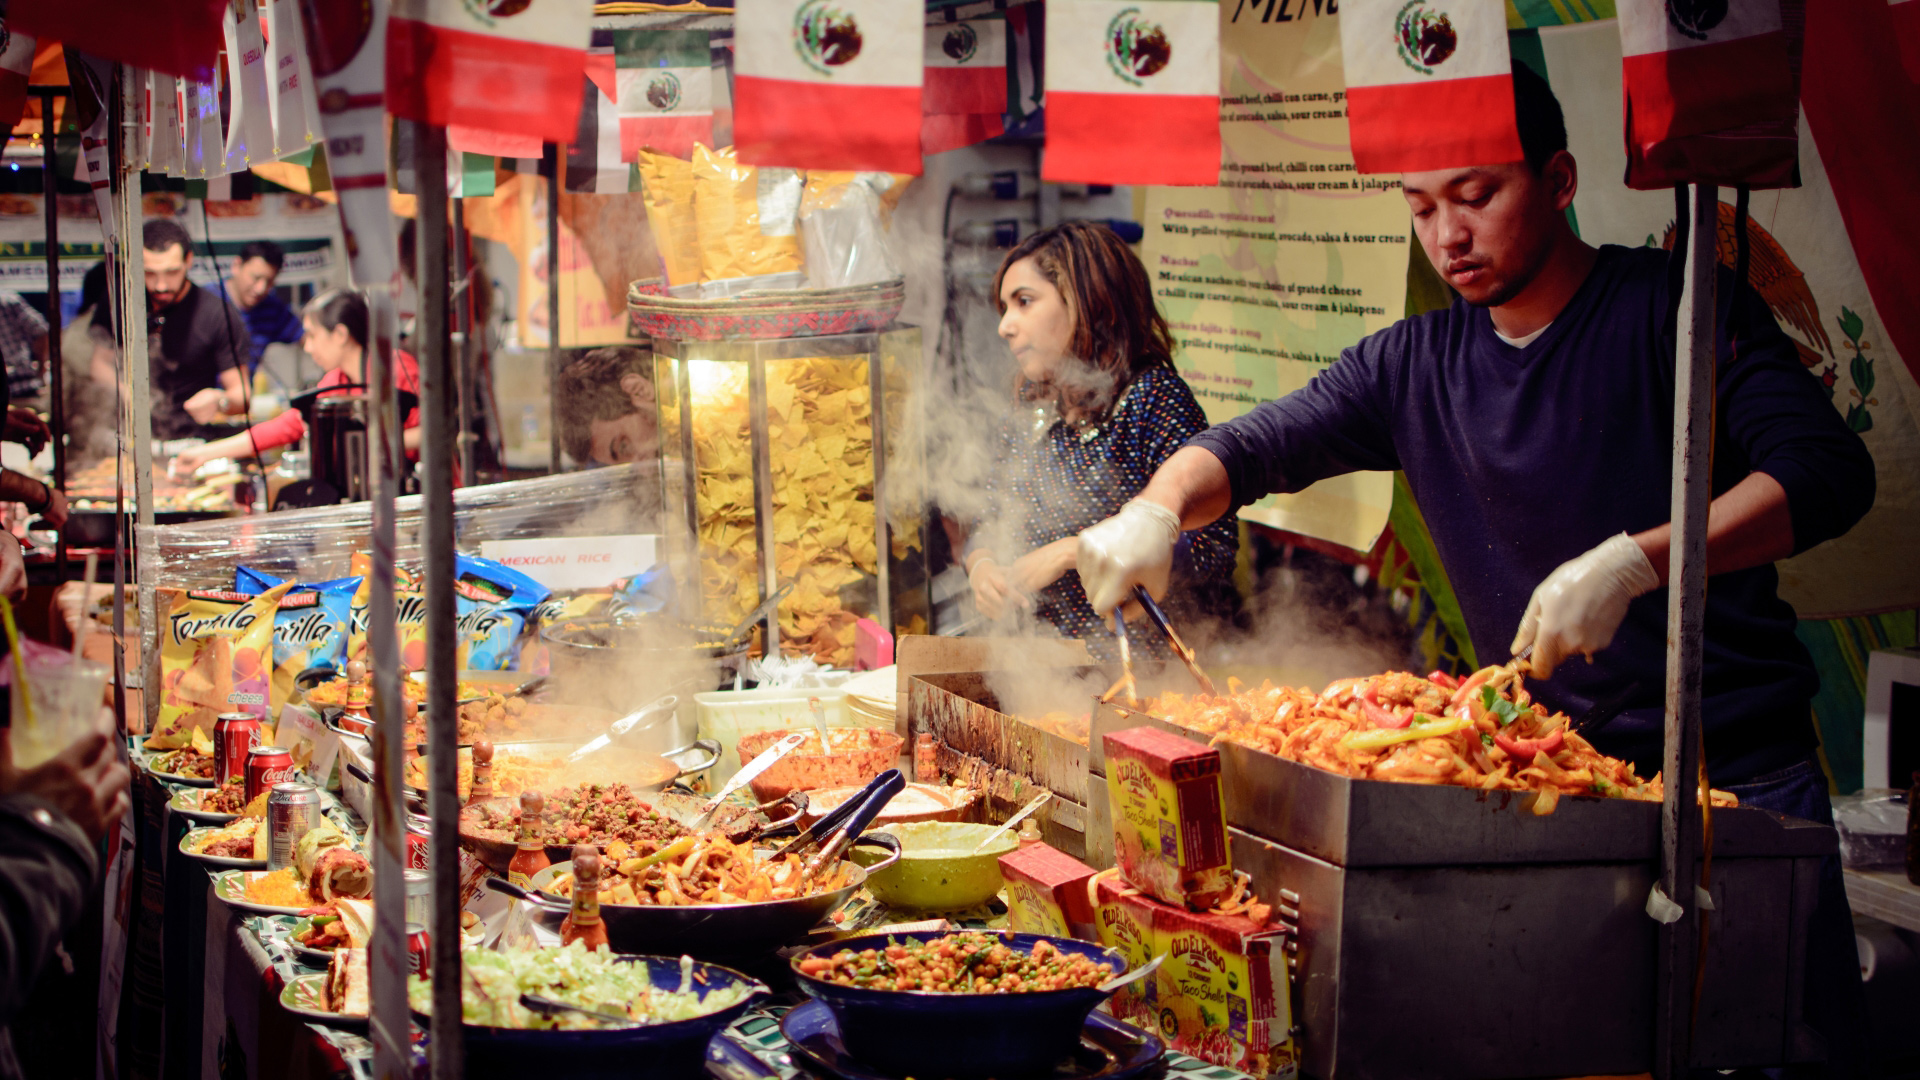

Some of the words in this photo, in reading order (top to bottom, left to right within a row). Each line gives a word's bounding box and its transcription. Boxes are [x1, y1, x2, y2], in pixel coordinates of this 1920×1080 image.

[1312, 110, 1343, 119] cream
[1309, 164, 1326, 172] con
[1318, 181, 1349, 190] cream
[1352, 178, 1359, 189] &
[1361, 178, 1403, 192] jalapen
[1163, 224, 1188, 234] With
[1316, 231, 1341, 243] salsa
[1343, 231, 1350, 243] &
[1352, 235, 1376, 243] sour
[1158, 271, 1202, 283] Mexican
[1328, 284, 1362, 296] cheese
[1300, 303, 1329, 312] cream
[1331, 301, 1338, 312] &
[499, 555, 566, 566] MEXICAN
[577, 553, 612, 563] RICE
[170, 602, 257, 646] Tortilla
[227, 691, 264, 705] cheese
[1122, 804, 1138, 823] Taco
[1137, 809, 1157, 829] Shells
[1171, 937, 1189, 960] OLD
[1189, 934, 1203, 956] EL
[1178, 978, 1200, 997] Taco
[1199, 983, 1225, 1004] Shells
